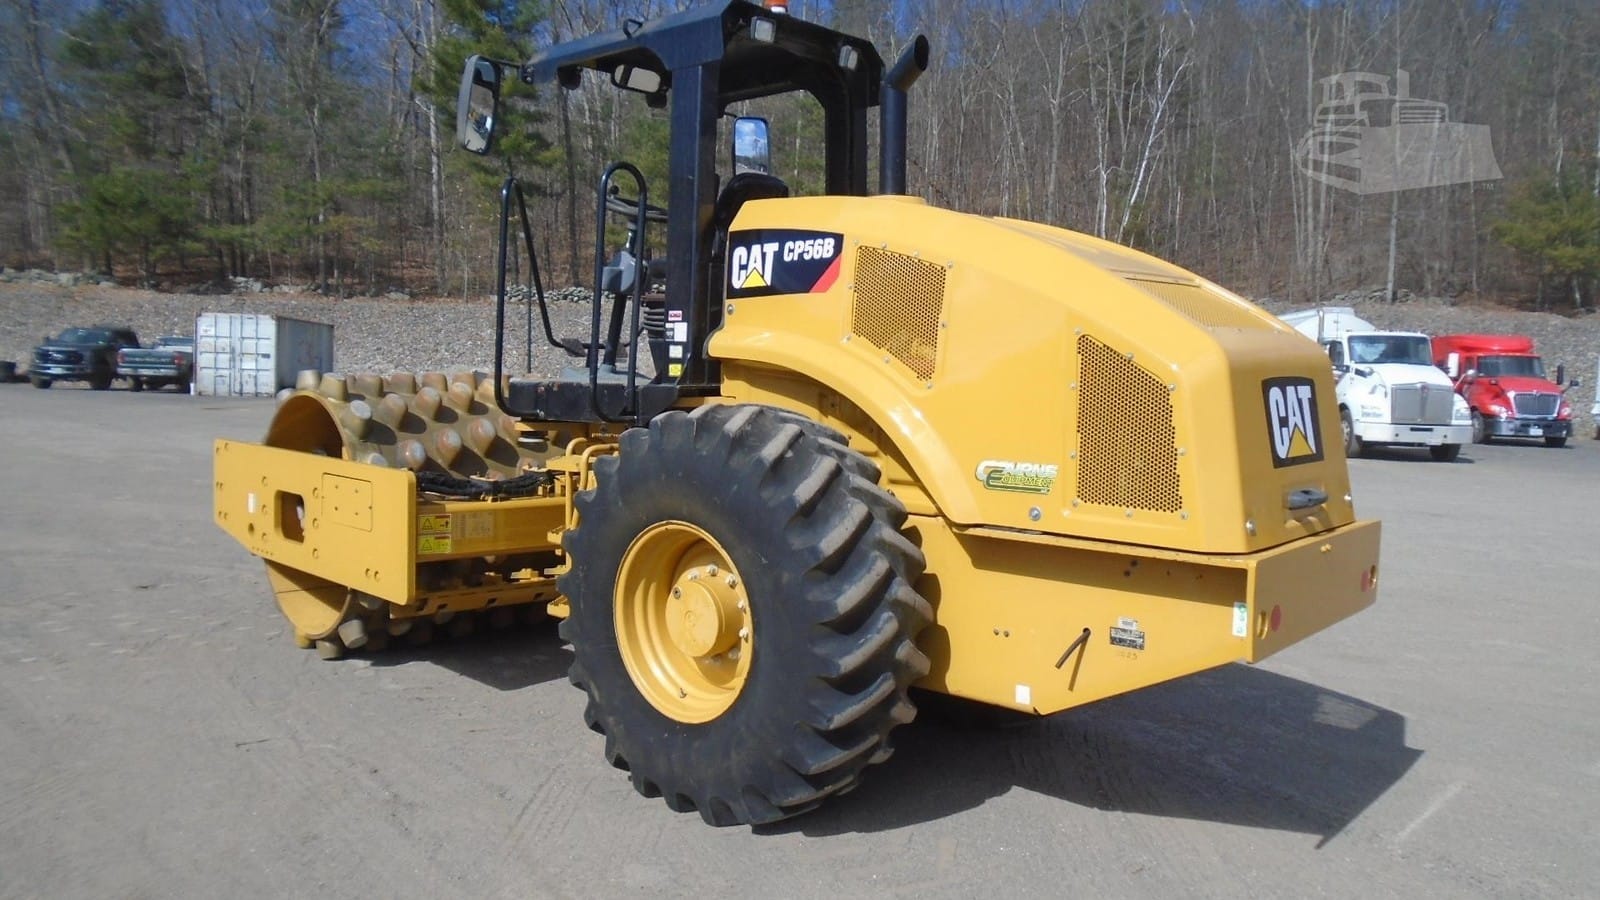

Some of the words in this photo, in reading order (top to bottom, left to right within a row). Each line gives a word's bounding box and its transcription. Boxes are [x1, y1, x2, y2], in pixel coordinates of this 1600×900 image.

[731, 242, 779, 289] CAT
[783, 237, 835, 262] CP56B
[1269, 385, 1316, 459] CAT
